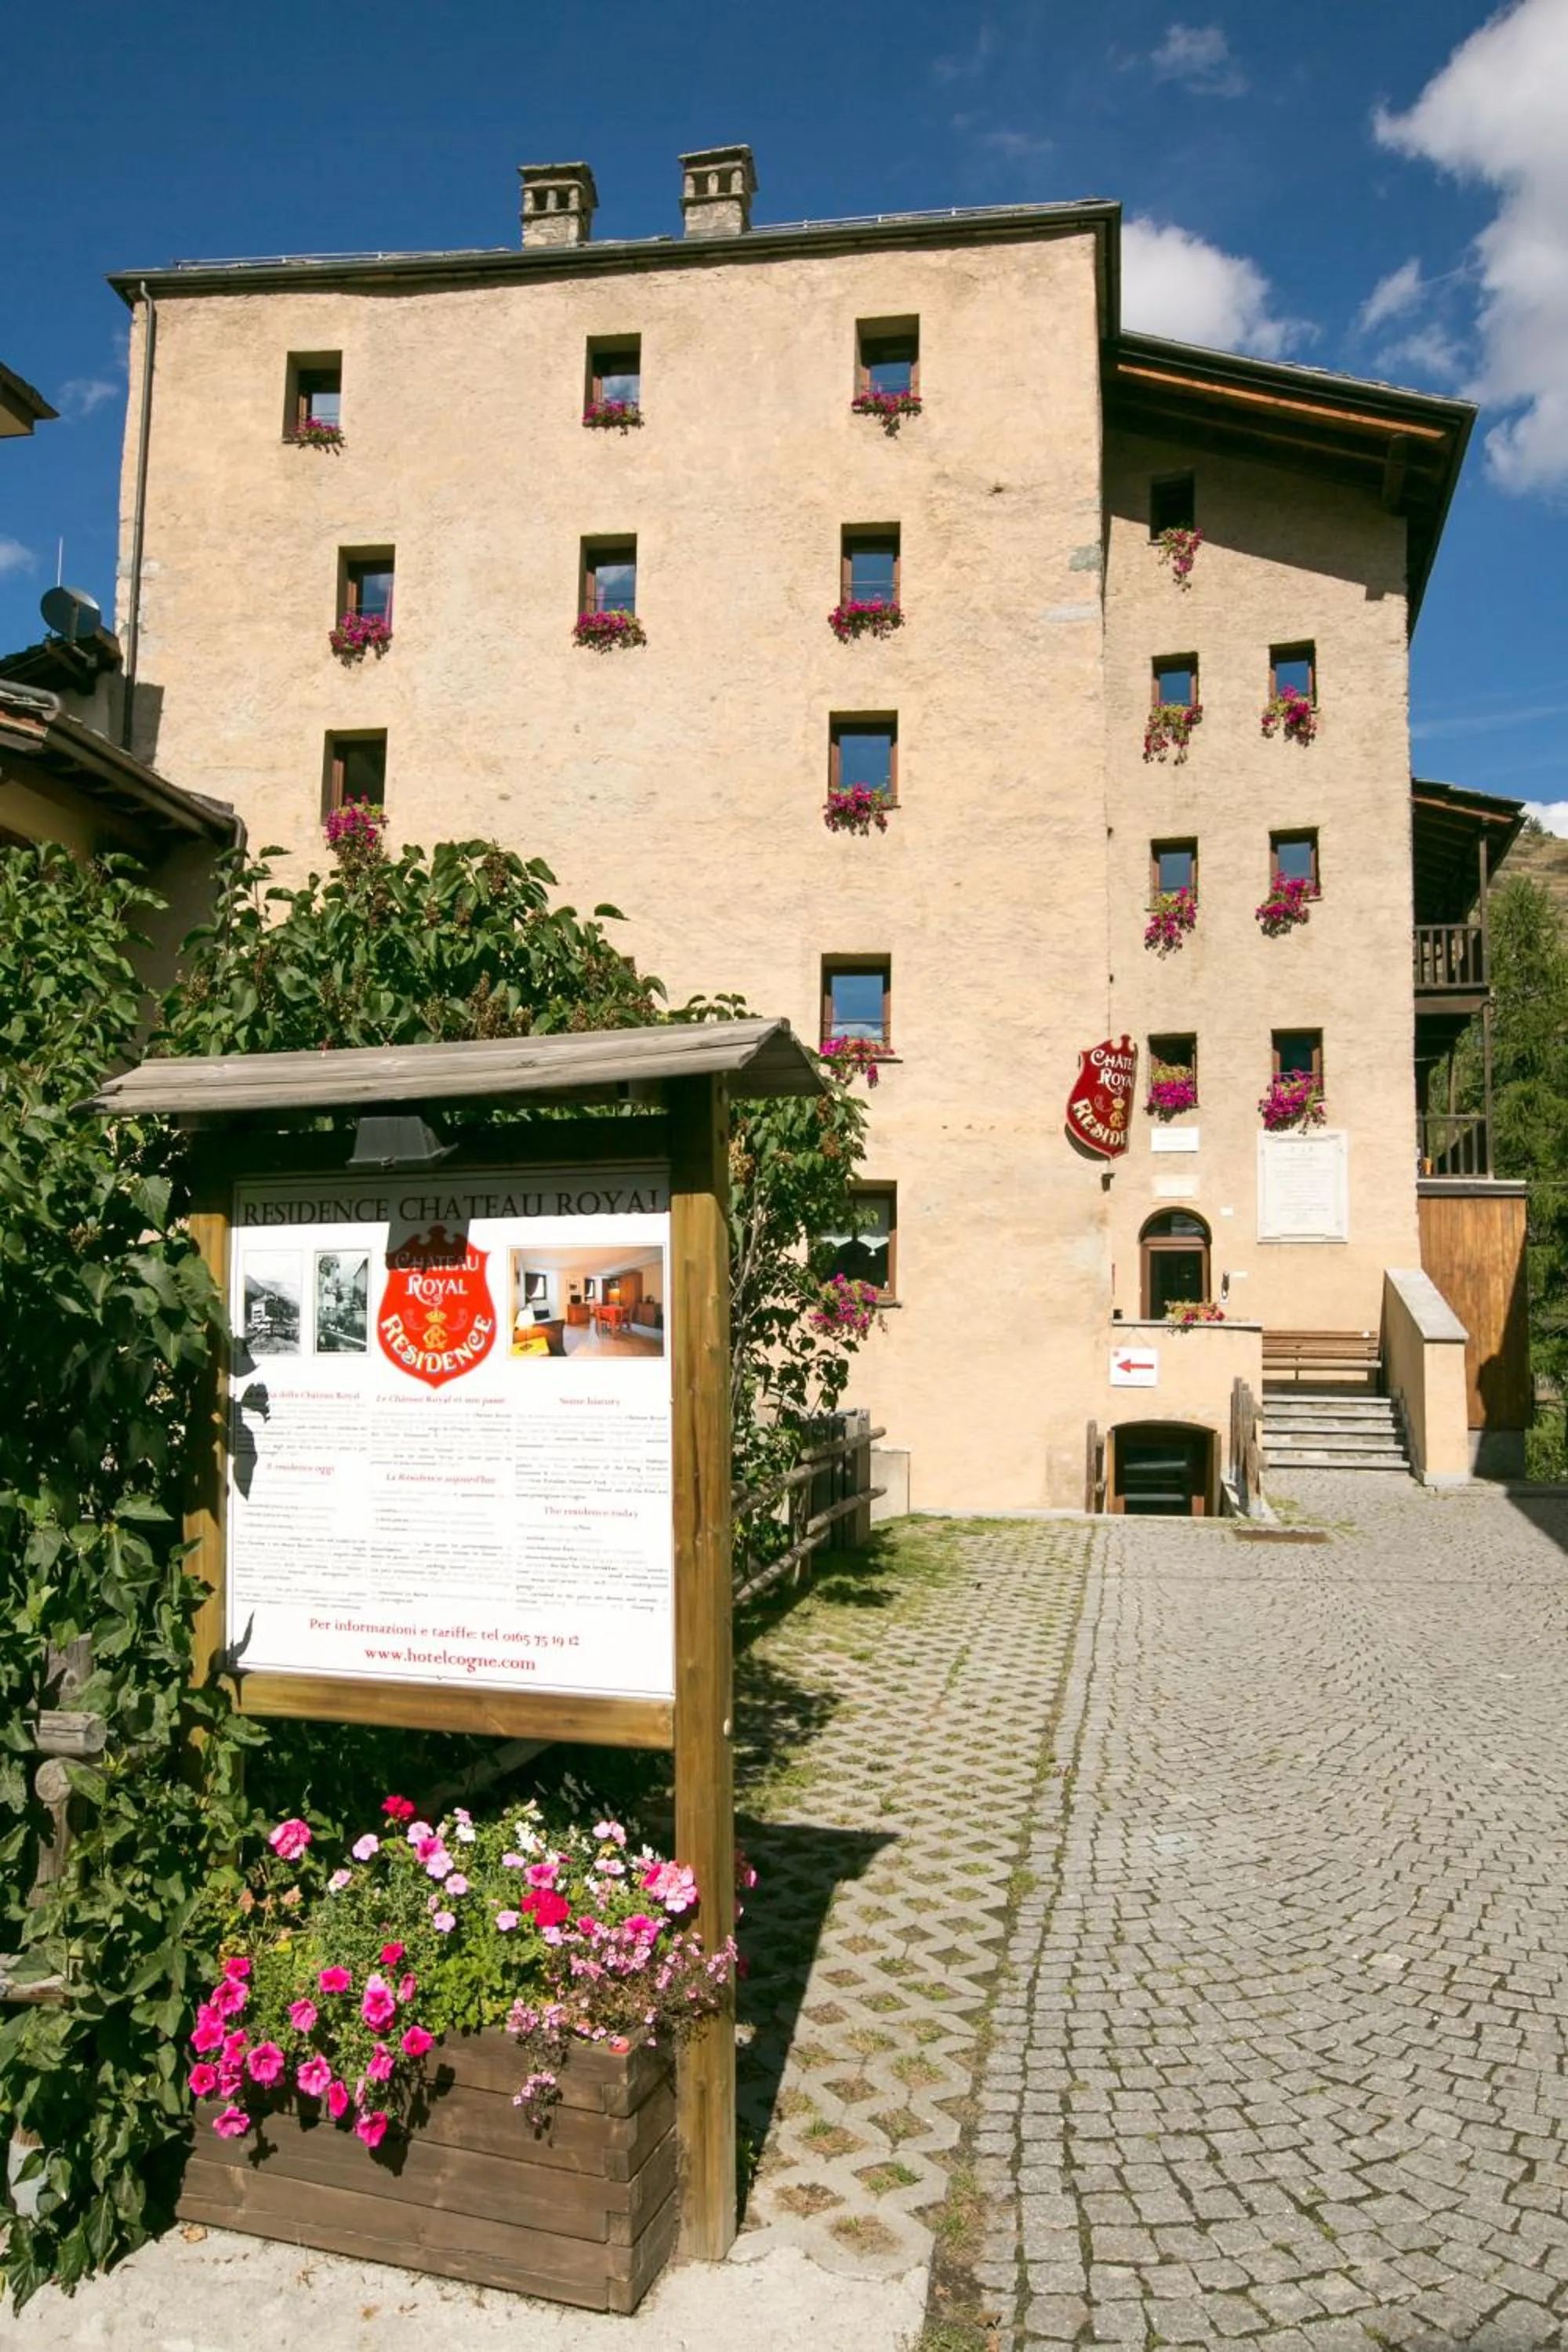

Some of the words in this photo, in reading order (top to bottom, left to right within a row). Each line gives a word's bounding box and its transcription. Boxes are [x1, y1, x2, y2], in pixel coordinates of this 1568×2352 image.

[1097, 1068, 1134, 1094] ROYA
[244, 1198, 390, 1225] RESIDENCE
[399, 1192, 543, 1221] CHATEAU
[555, 1189, 670, 1215] ROYAL
[405, 1273, 469, 1305] ROYAL
[380, 1313, 492, 1373] RESIDENCE
[309, 1617, 332, 1630] Per
[335, 1618, 417, 1636] informazioni
[420, 1628, 429, 1637] e
[481, 1628, 499, 1640] tel
[502, 1630, 531, 1646] 0165
[552, 1633, 564, 1647] 19
[568, 1635, 580, 1646] 12
[365, 1647, 536, 1673] www.hotelcogne.com
